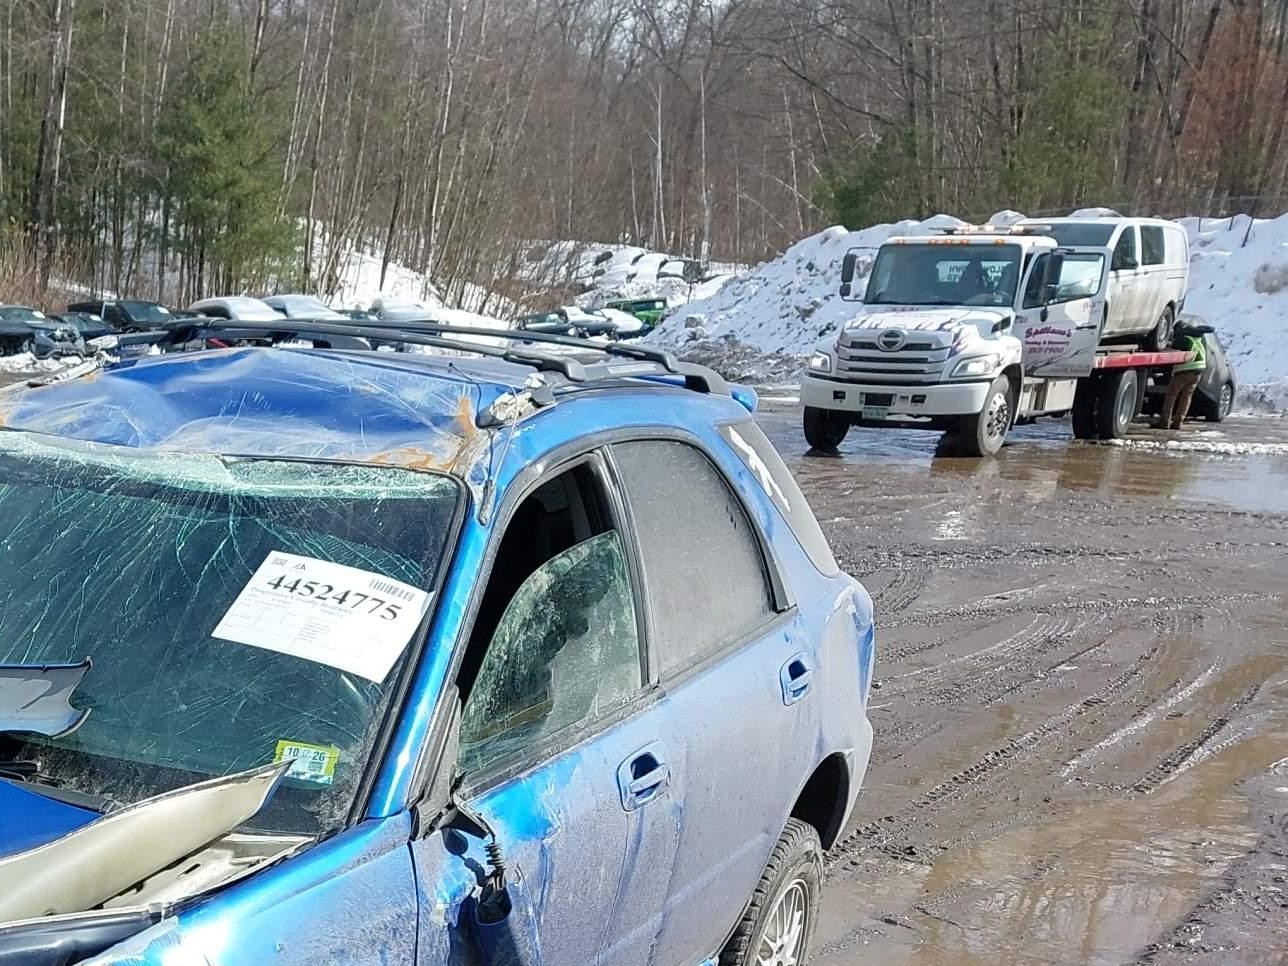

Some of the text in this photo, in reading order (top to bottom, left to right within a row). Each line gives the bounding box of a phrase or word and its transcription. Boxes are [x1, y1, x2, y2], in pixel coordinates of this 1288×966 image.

[267, 574, 402, 621] 44524775
[287, 747, 300, 758] 10
[312, 751, 326, 762] 26
